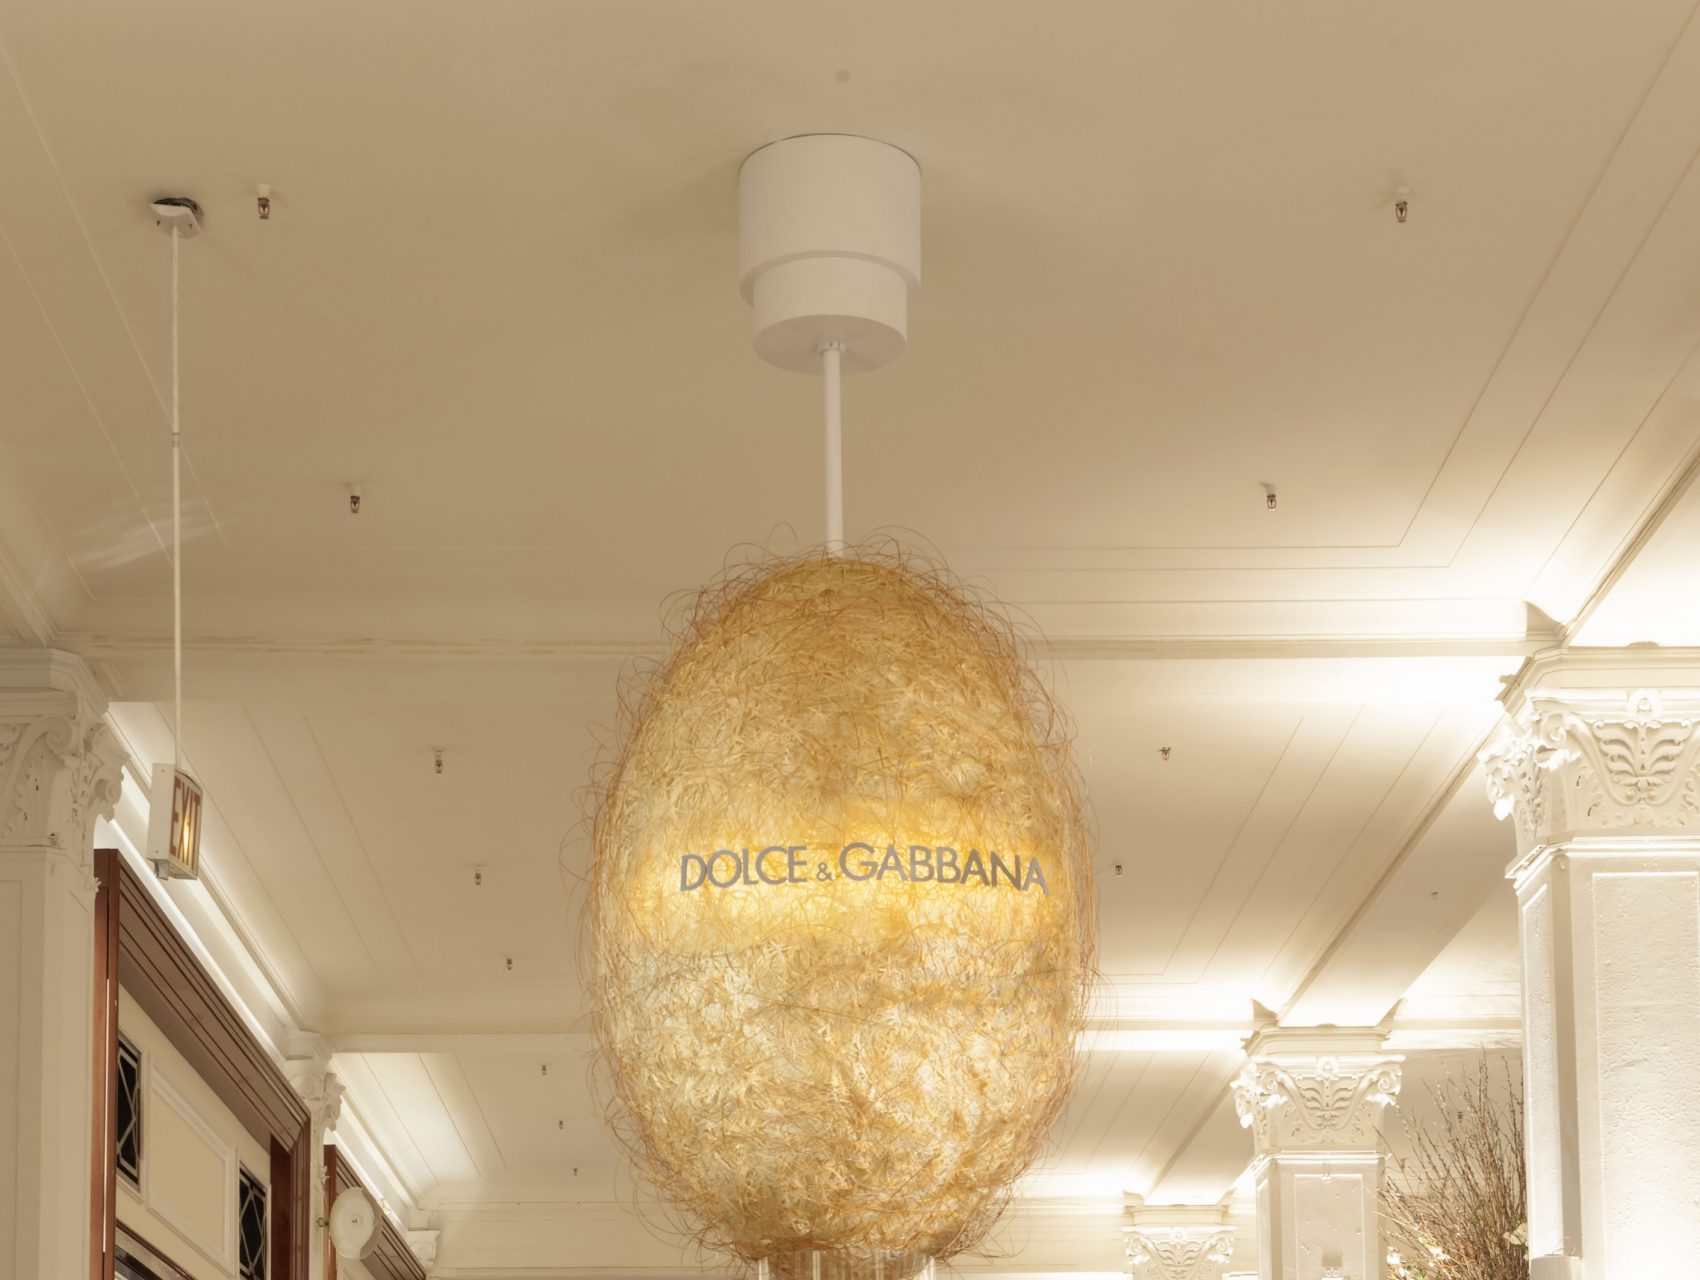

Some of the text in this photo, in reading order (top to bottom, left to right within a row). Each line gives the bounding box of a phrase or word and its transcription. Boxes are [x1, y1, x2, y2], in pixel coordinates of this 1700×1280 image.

[169, 775, 201, 870] EXIT
[680, 842, 1050, 896] DOLCE & GABBANA
